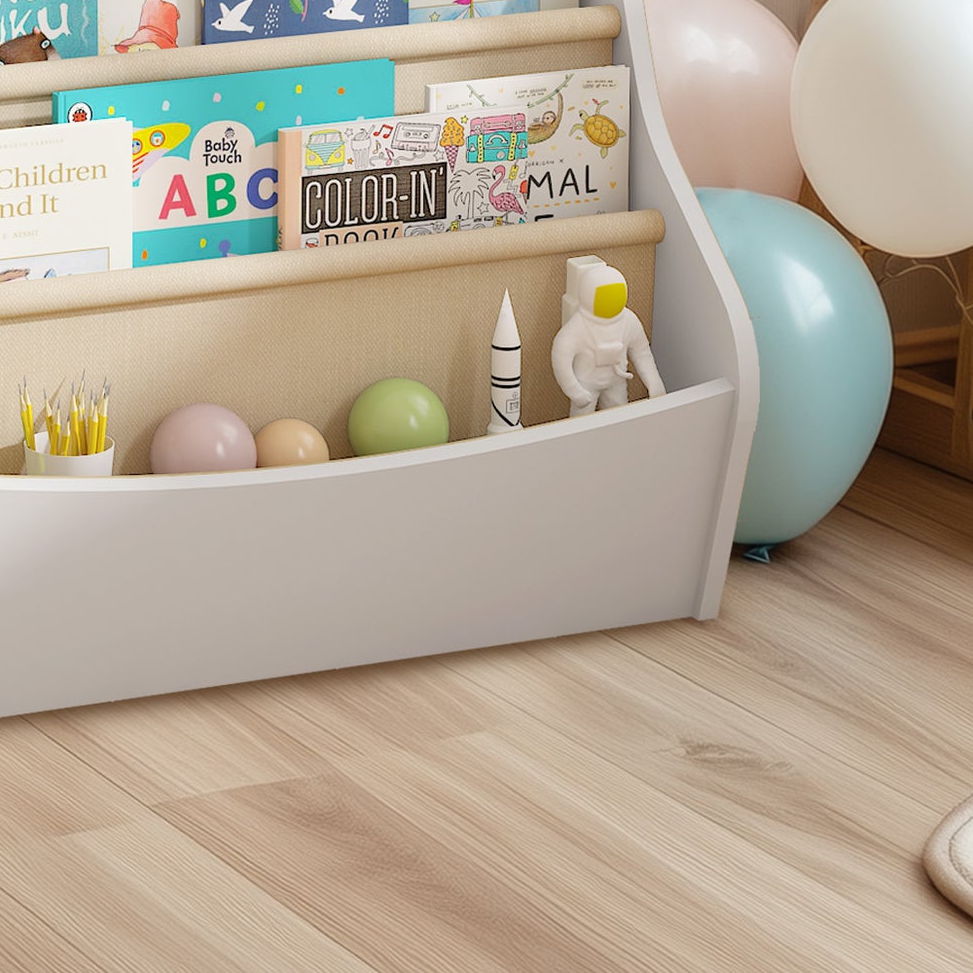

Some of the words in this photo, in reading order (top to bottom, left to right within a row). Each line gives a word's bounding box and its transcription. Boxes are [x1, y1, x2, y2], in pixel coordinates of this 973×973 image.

[205, 138, 238, 153] Baby
[203, 150, 242, 167] Touch
[527, 164, 598, 200] MAL
[40, 193, 59, 215] It
